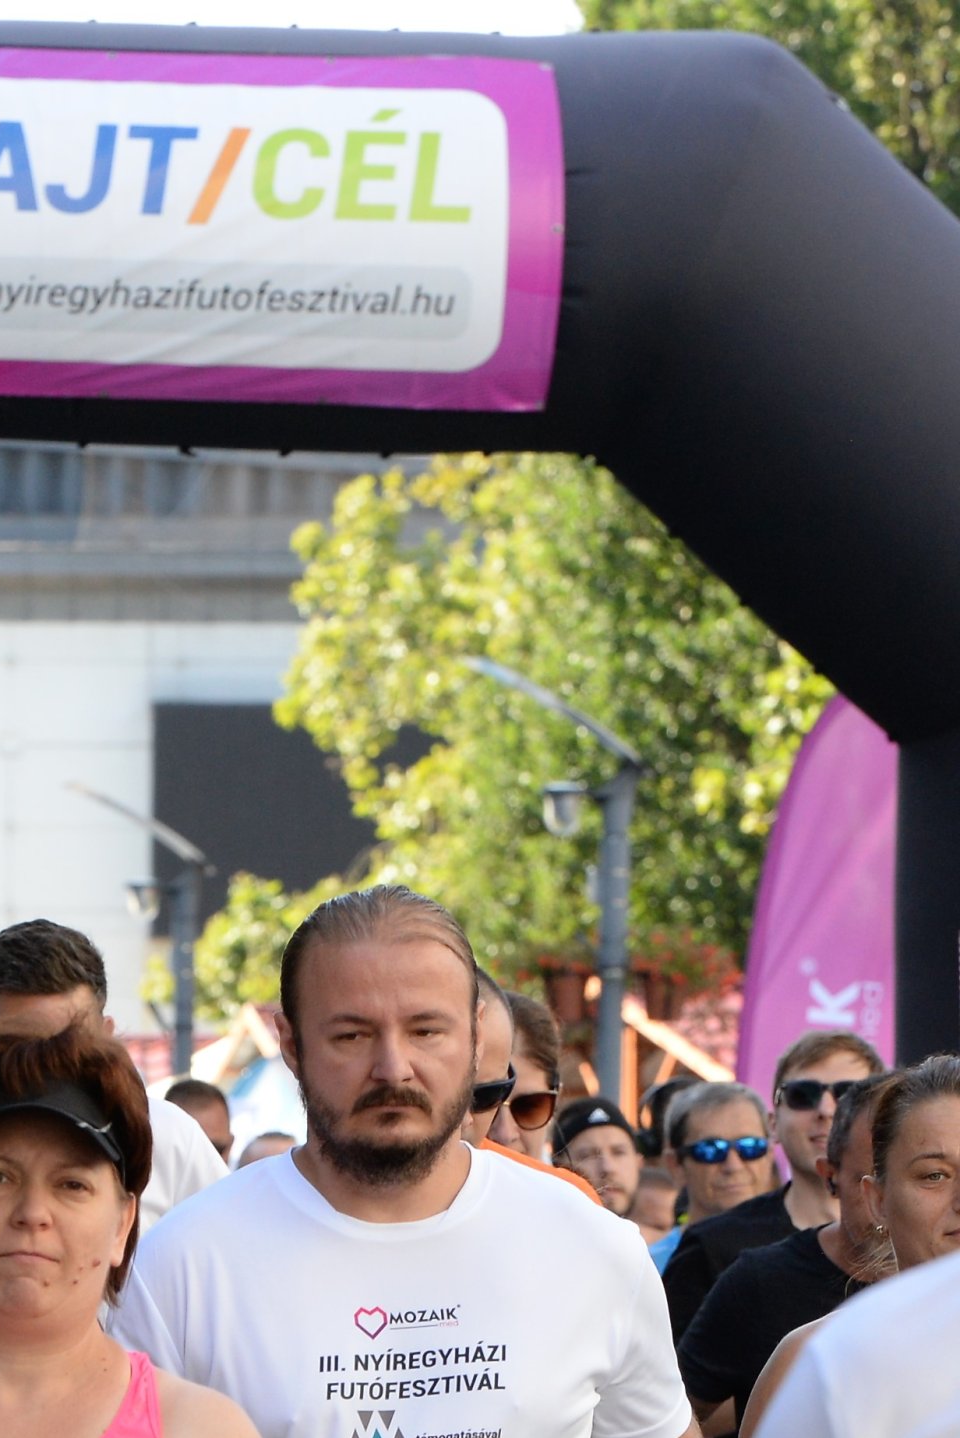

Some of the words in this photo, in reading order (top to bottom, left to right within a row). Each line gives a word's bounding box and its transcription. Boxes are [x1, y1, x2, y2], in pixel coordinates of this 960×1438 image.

[390, 1307, 457, 1325] MOZAIK
[319, 1355, 346, 1373] III.
[354, 1340, 507, 1371] NYÍREGYHÁZI
[326, 1367, 506, 1401] FUTÓFESZTIVÁL
